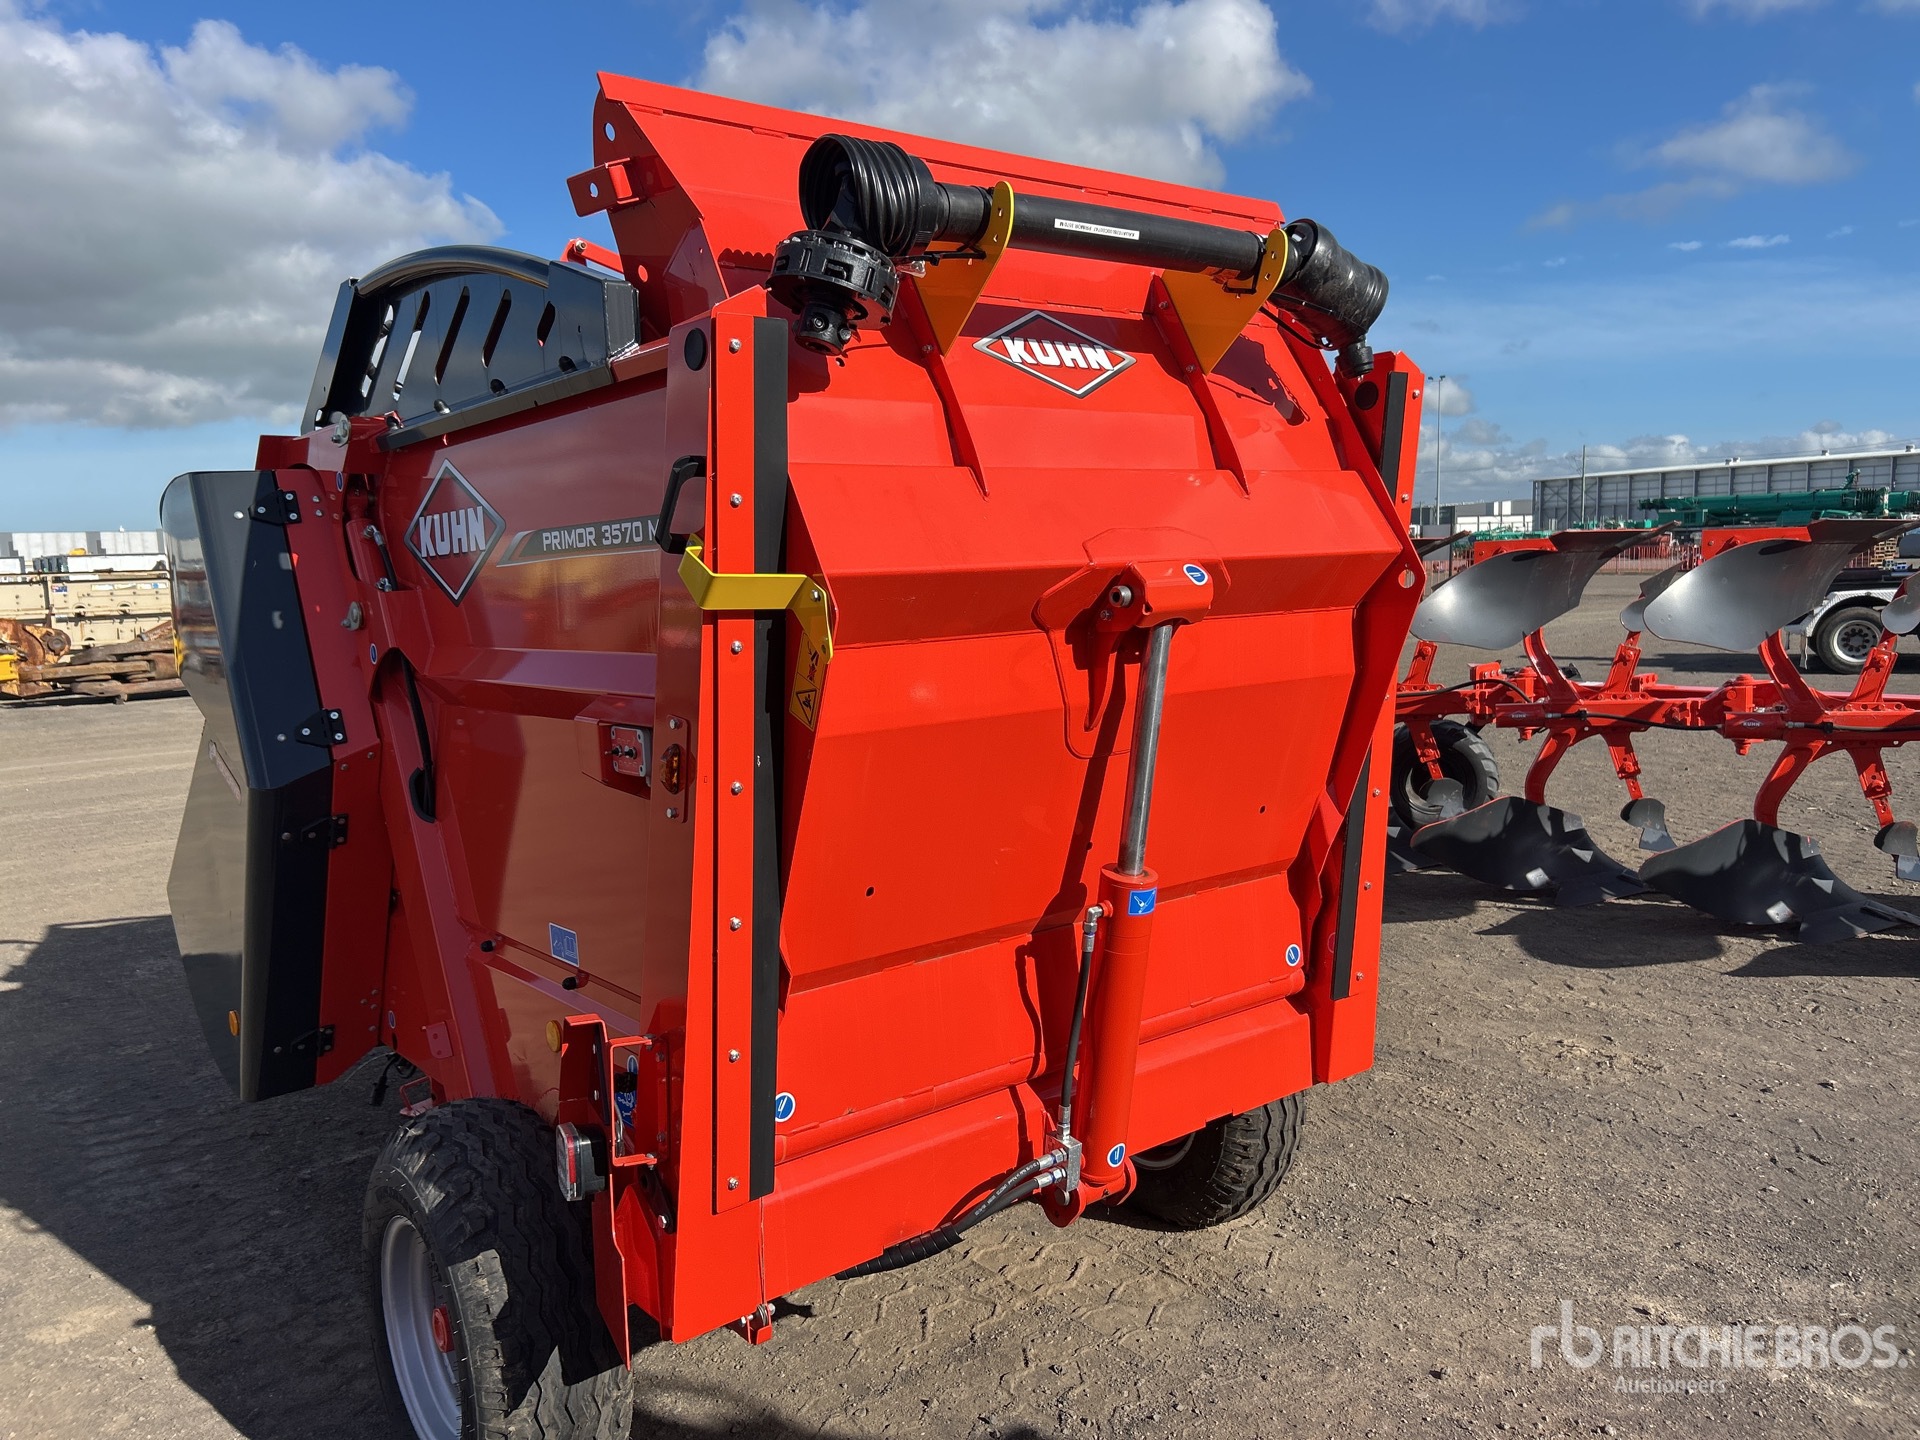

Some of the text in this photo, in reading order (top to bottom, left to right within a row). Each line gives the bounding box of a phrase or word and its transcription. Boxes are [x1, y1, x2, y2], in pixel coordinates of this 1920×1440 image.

[1001, 335, 1114, 371] KUHN
[419, 506, 486, 557] KUHN
[542, 526, 598, 551] PRIMOR
[601, 521, 643, 545] 3570
